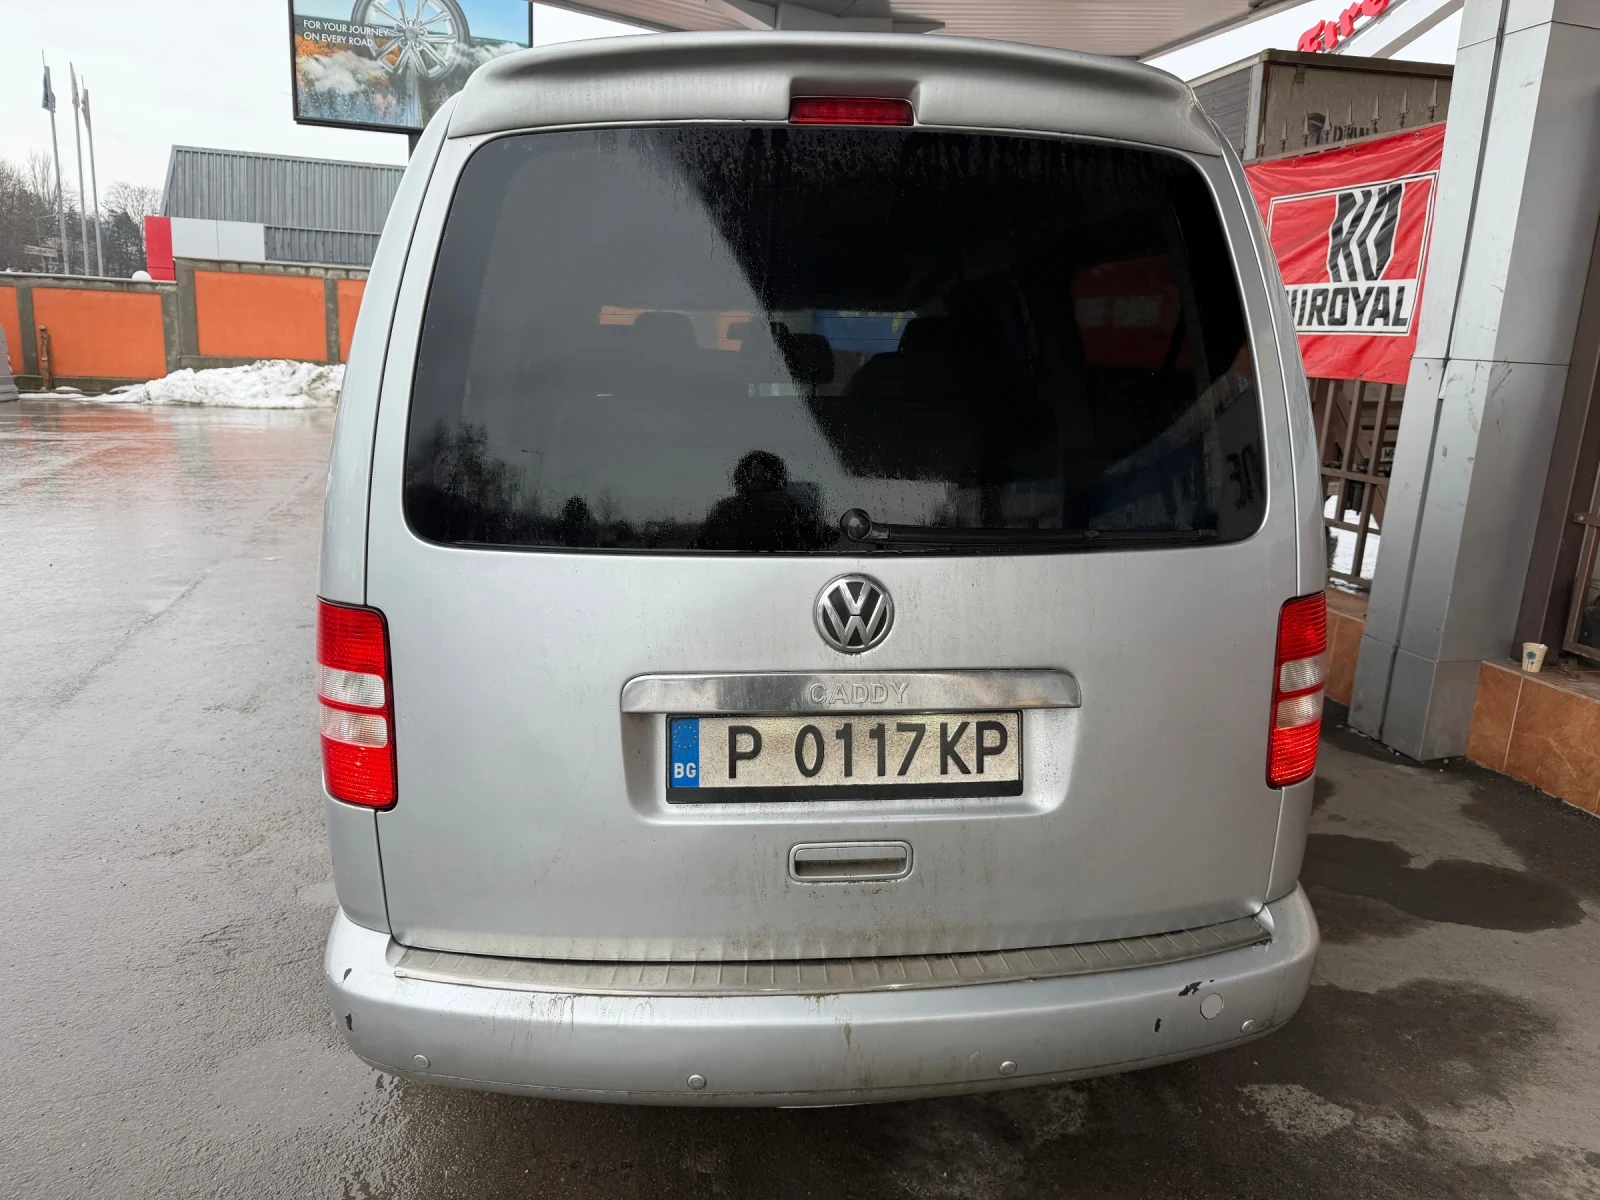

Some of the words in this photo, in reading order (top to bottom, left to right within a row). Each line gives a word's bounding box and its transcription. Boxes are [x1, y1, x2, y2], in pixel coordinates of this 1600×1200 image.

[303, 19, 321, 30] FOR
[323, 22, 348, 33] YOUR
[348, 25, 389, 37] JOURNEY
[303, 31, 319, 41] ON
[321, 33, 347, 44] EVERY
[348, 37, 374, 47] ROAD
[809, 682, 909, 705] CADDY
[728, 725, 762, 779] P
[674, 762, 697, 779] BG
